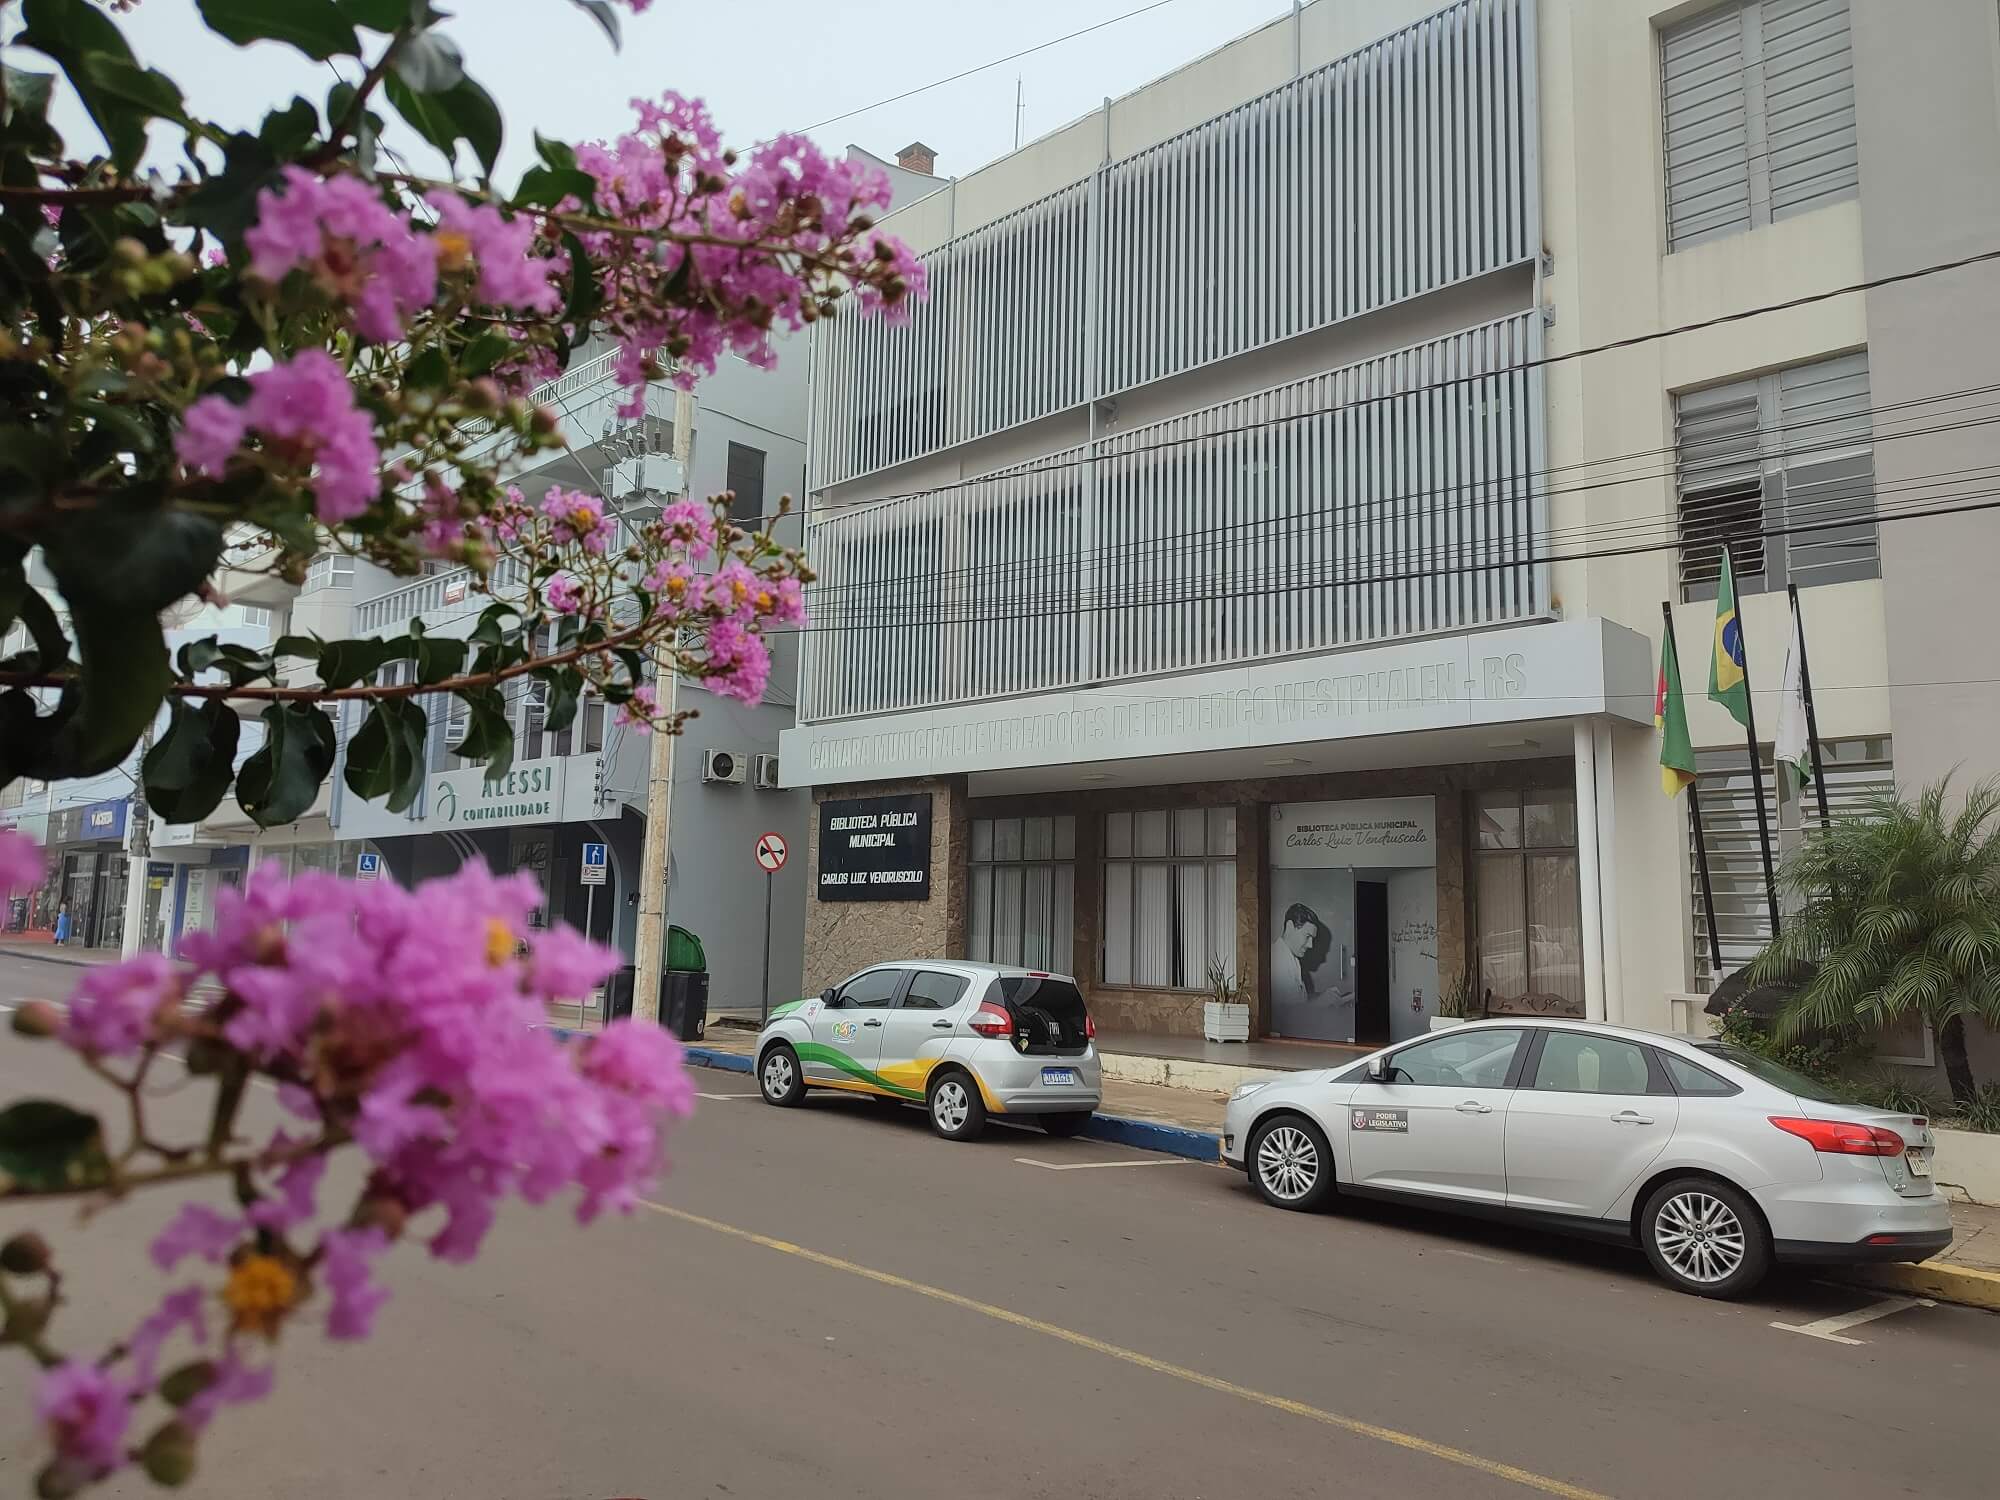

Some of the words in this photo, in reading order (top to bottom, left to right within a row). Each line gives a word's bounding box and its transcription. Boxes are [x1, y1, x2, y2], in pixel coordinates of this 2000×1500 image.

[873, 725, 960, 764] MUNICIPAL
[988, 706, 1105, 751] VEREADORES
[1113, 704, 1140, 739] DE
[1145, 687, 1265, 736] FREDERICO
[1275, 662, 1456, 724] WESTPHALEN
[1482, 653, 1527, 699] RS
[482, 767, 551, 798] ALESSI
[464, 802, 550, 821] CONTABILIDADE
[830, 815, 877, 830] BIBLIOTECA
[880, 811, 917, 828] PÚBLICA
[1296, 824, 1340, 833] BIBLIOTECA
[1340, 821, 1373, 832] PÚBLICA
[1374, 820, 1418, 830] MUNICIPAL
[849, 833, 896, 848] MUNICIPAL
[1286, 833, 1322, 848] Carlos
[1355, 829, 1428, 846] Vendruscolo
[821, 873, 848, 884] CARLOS
[850, 872, 867, 884] LUIZ
[869, 870, 923, 883] VENDRUSCOLO
[1368, 1119, 1407, 1128] LEGISLATIVO
[1375, 1112, 1397, 1120] PODER
